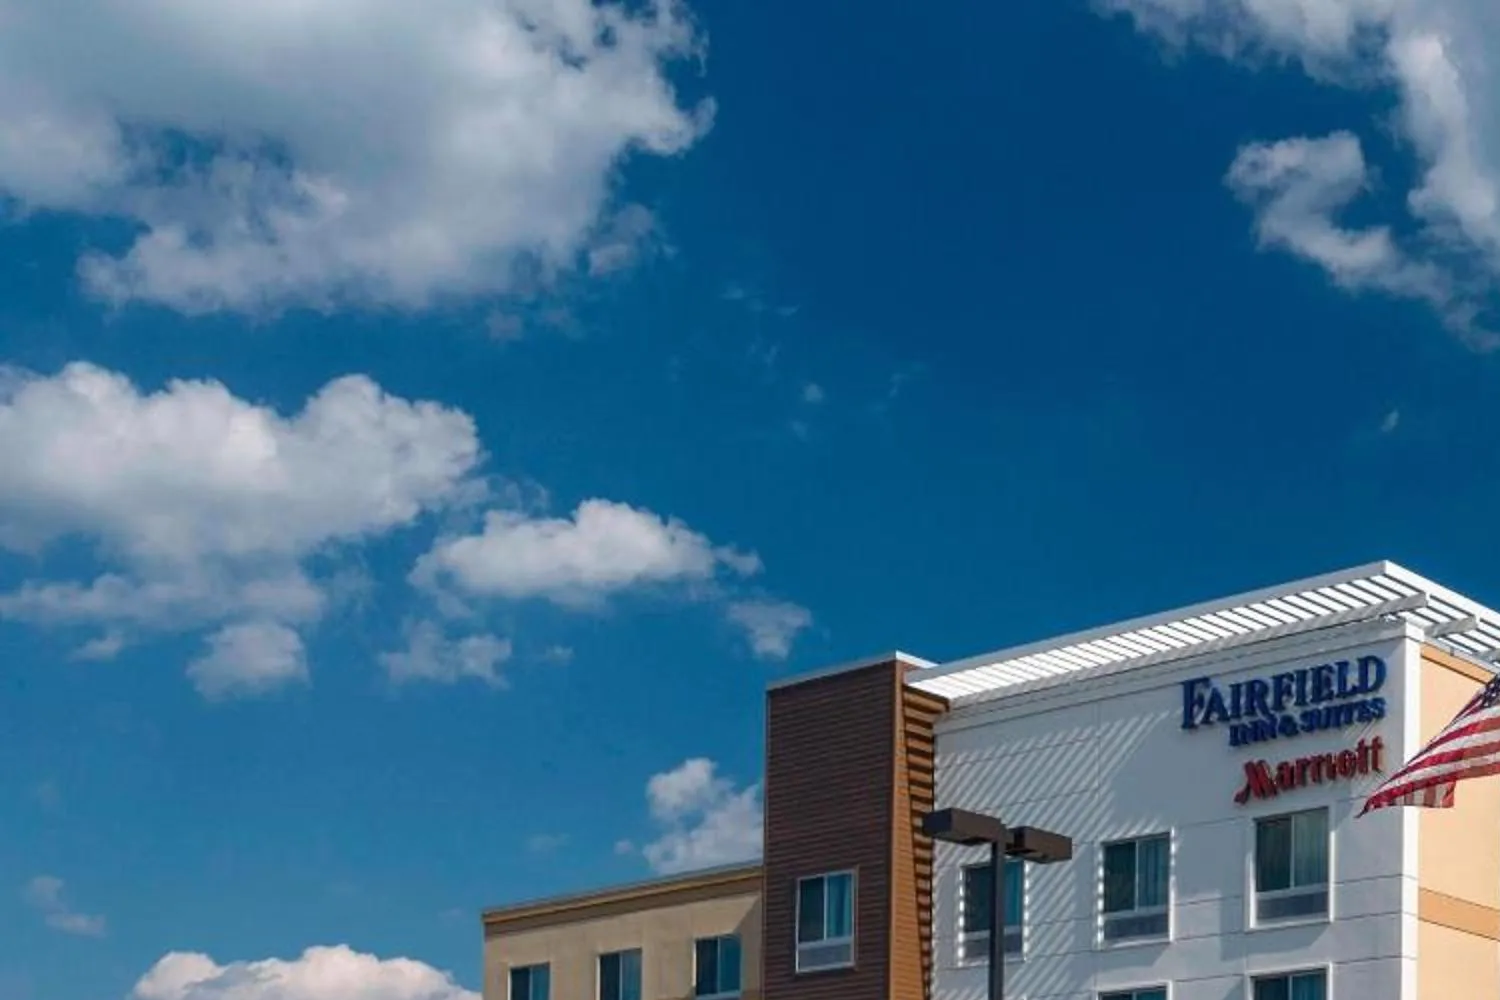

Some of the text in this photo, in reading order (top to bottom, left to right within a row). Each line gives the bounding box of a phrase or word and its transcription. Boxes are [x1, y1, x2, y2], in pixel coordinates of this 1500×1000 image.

[1180, 655, 1387, 730] FAIRFIELD
[1229, 697, 1386, 747] INN & SUITES
[1234, 735, 1384, 805] Marriott
